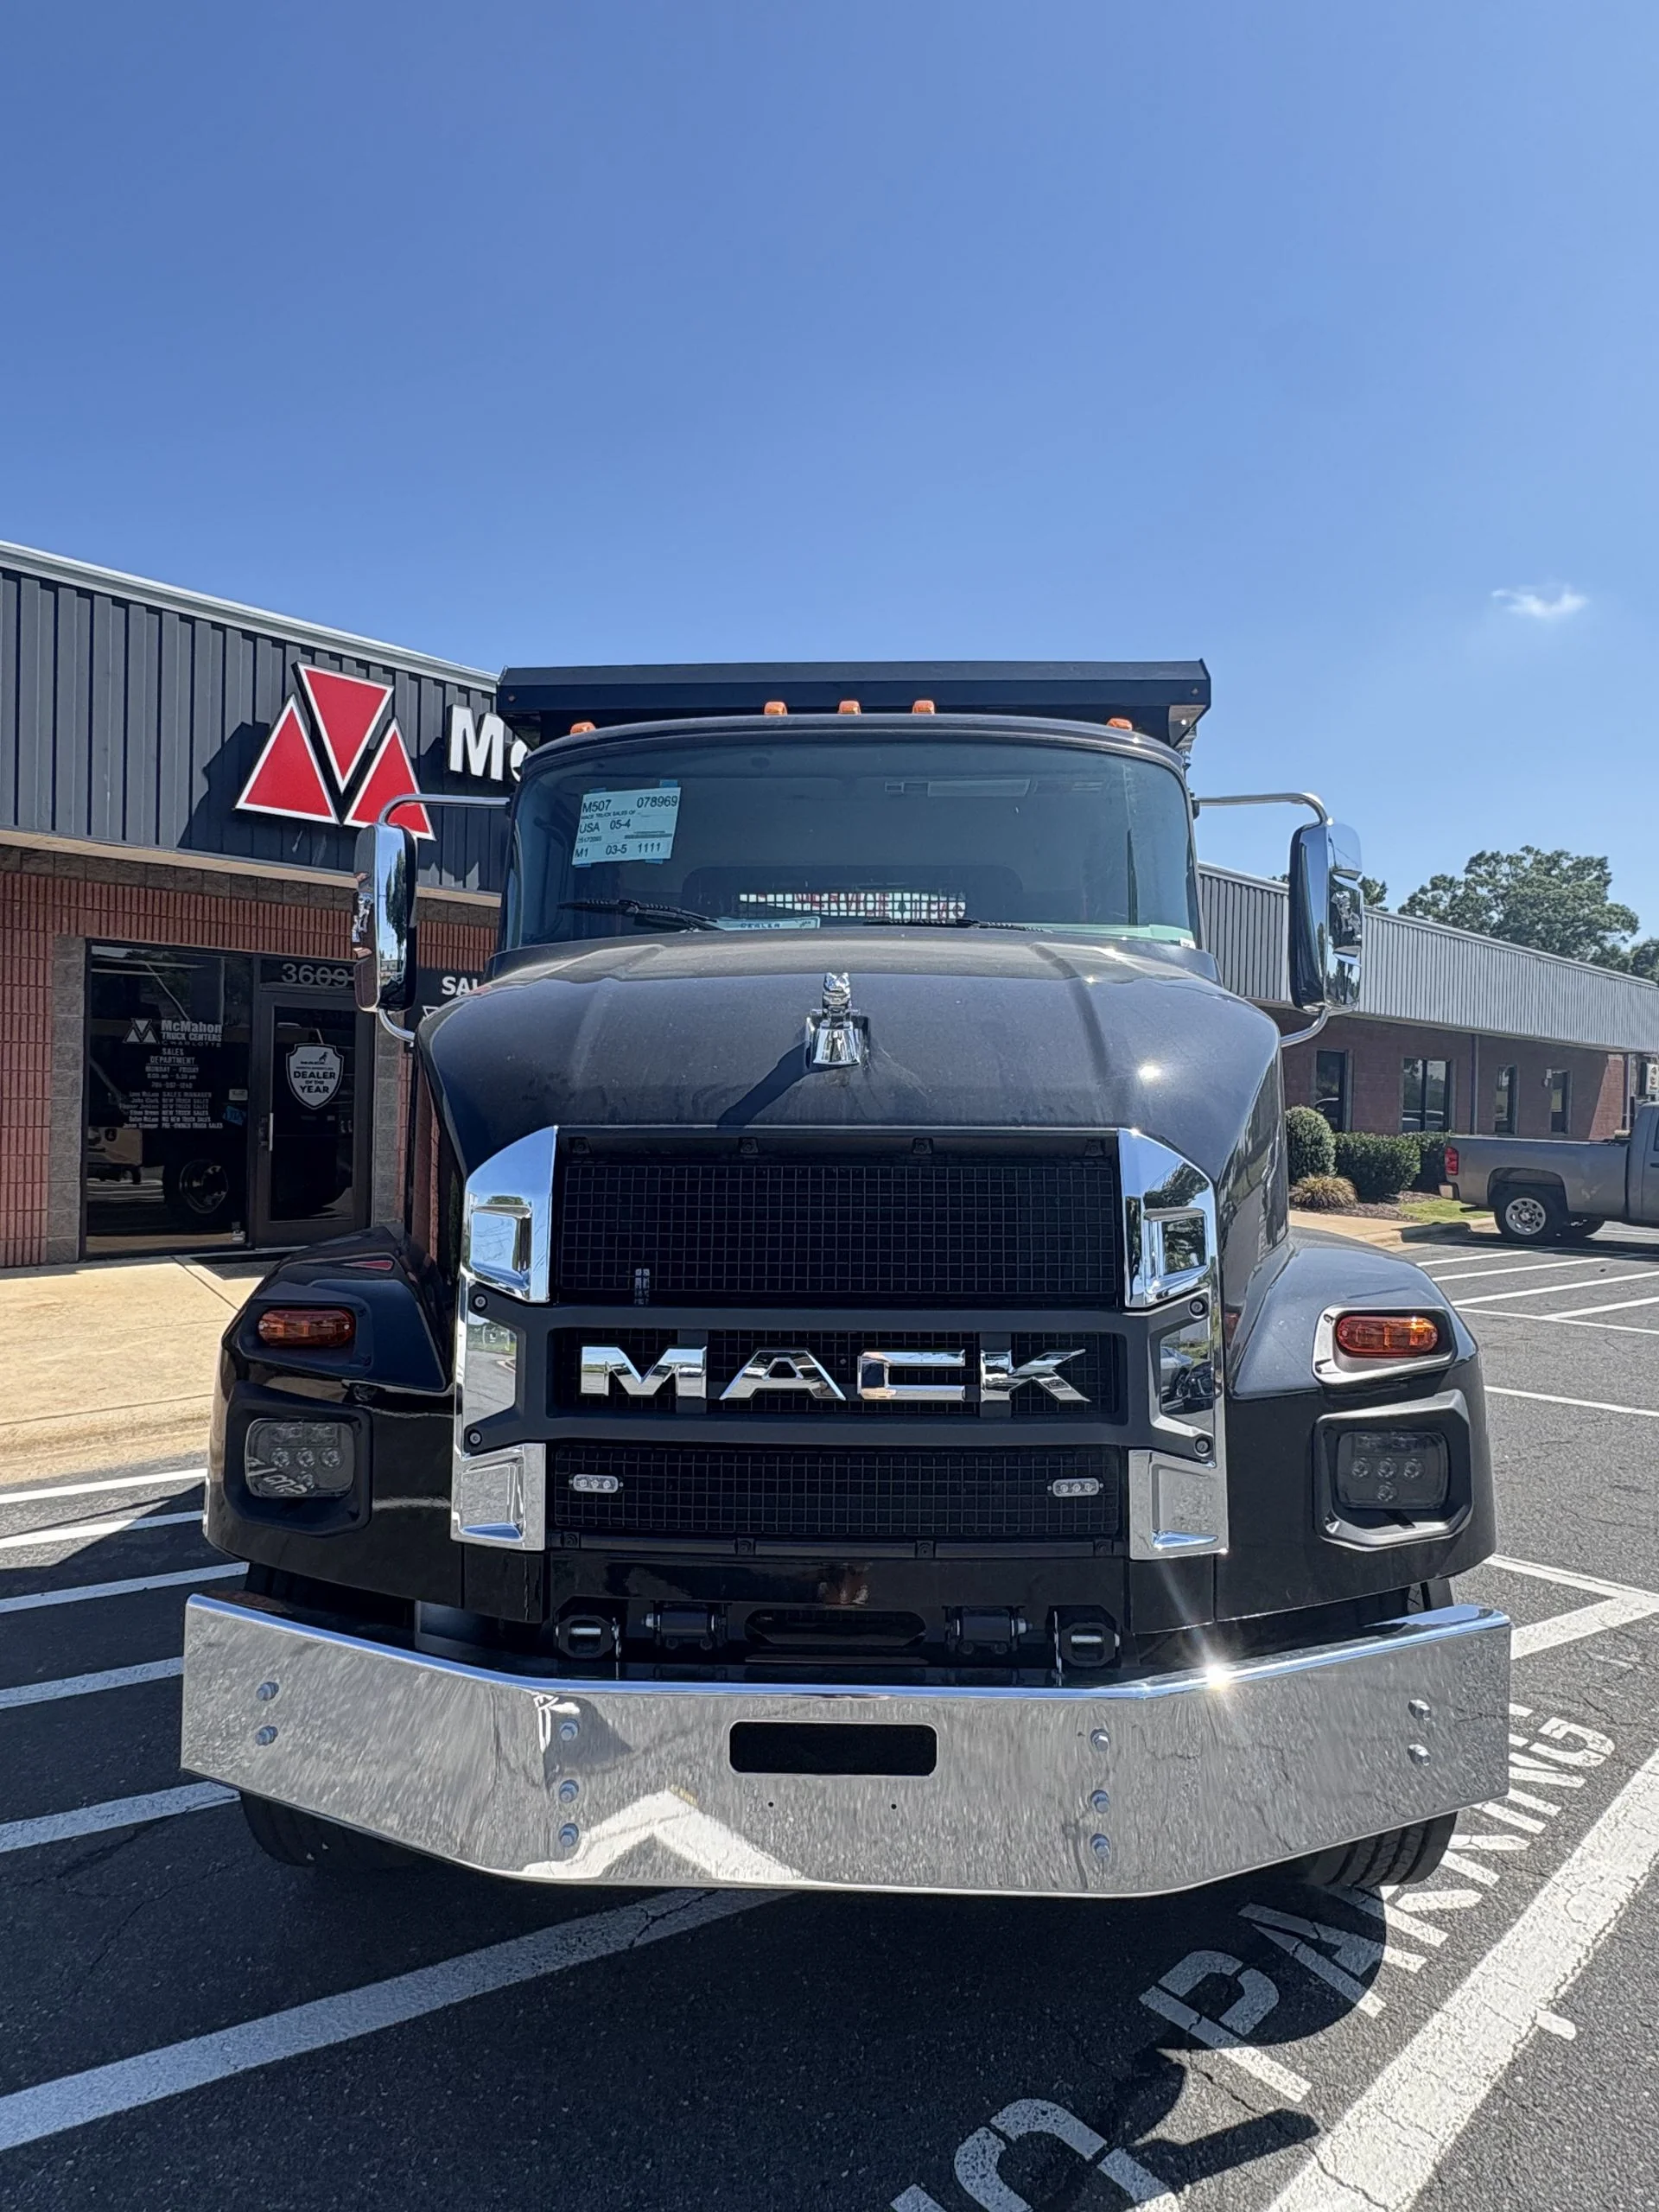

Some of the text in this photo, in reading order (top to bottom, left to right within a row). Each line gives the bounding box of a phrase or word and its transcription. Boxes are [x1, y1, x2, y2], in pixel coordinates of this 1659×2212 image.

[582, 795, 678, 813] M507 078969
[579, 819, 632, 834] USA 05-4
[575, 842, 661, 858] M1 03-5 1111
[162, 1020, 222, 1033] McMahon
[162, 1032, 221, 1042] TRUCK CENTERS
[162, 1047, 184, 1056] SALES
[149, 1055, 195, 1065] DEPARTMENT
[293, 1071, 336, 1080] DEALER
[300, 1085, 329, 1094] YEAR
[581, 1345, 1092, 1402] MACK
